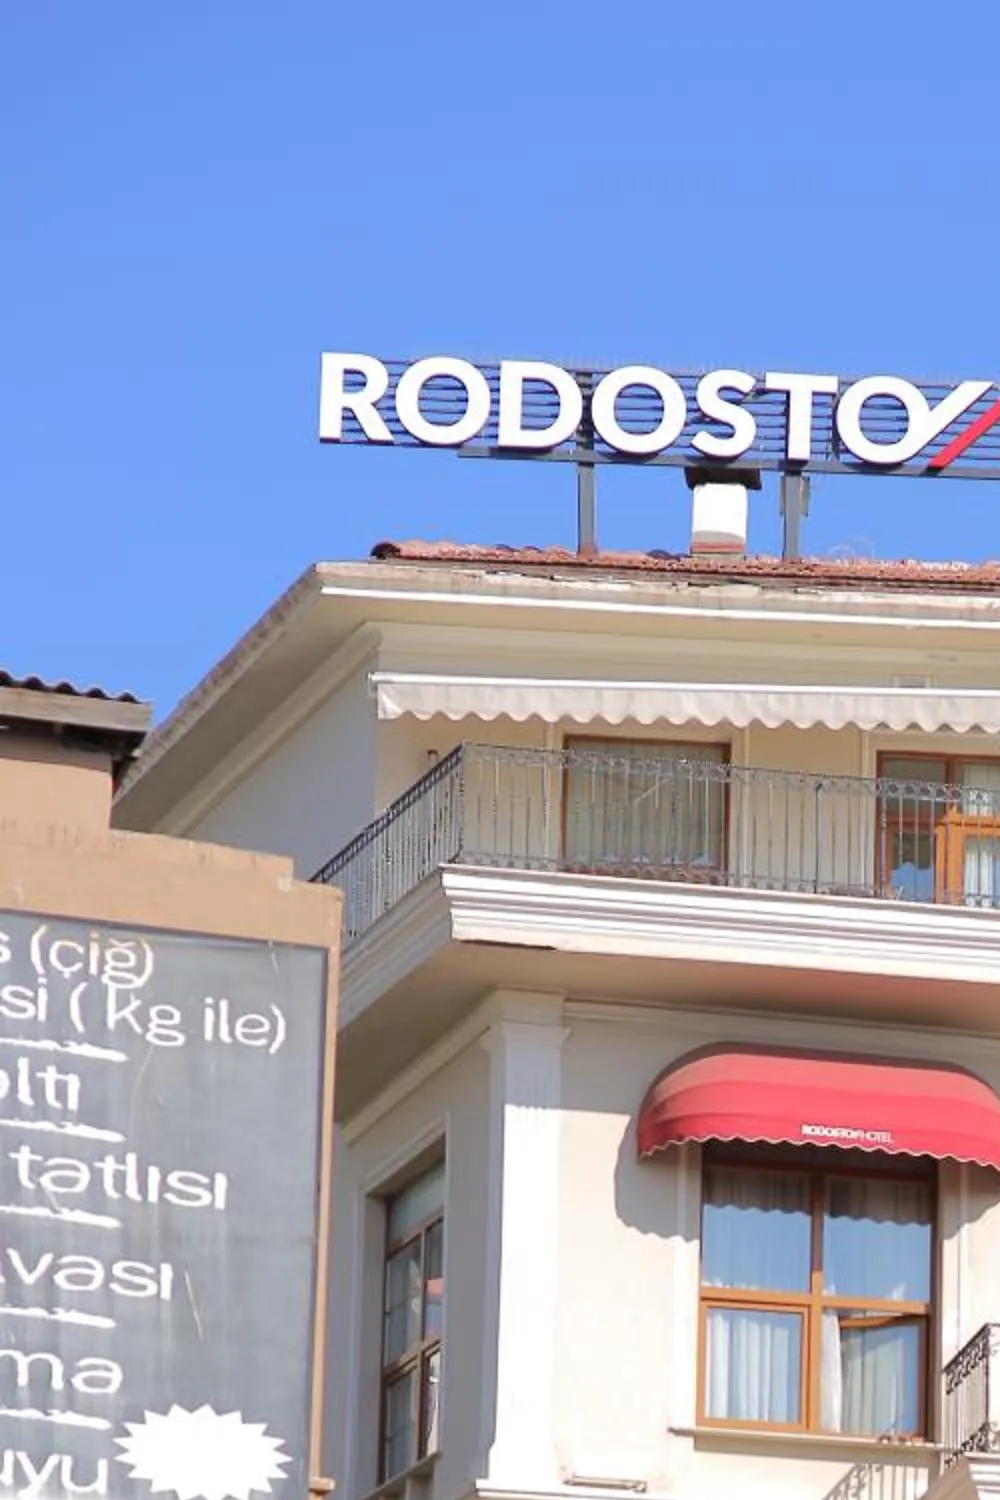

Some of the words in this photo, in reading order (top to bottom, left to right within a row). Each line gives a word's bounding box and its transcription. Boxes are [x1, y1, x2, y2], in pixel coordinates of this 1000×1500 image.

[203, 996, 286, 1054] ile)
[8, 1145, 227, 1210] tatlısı
[0, 1247, 174, 1302] vası
